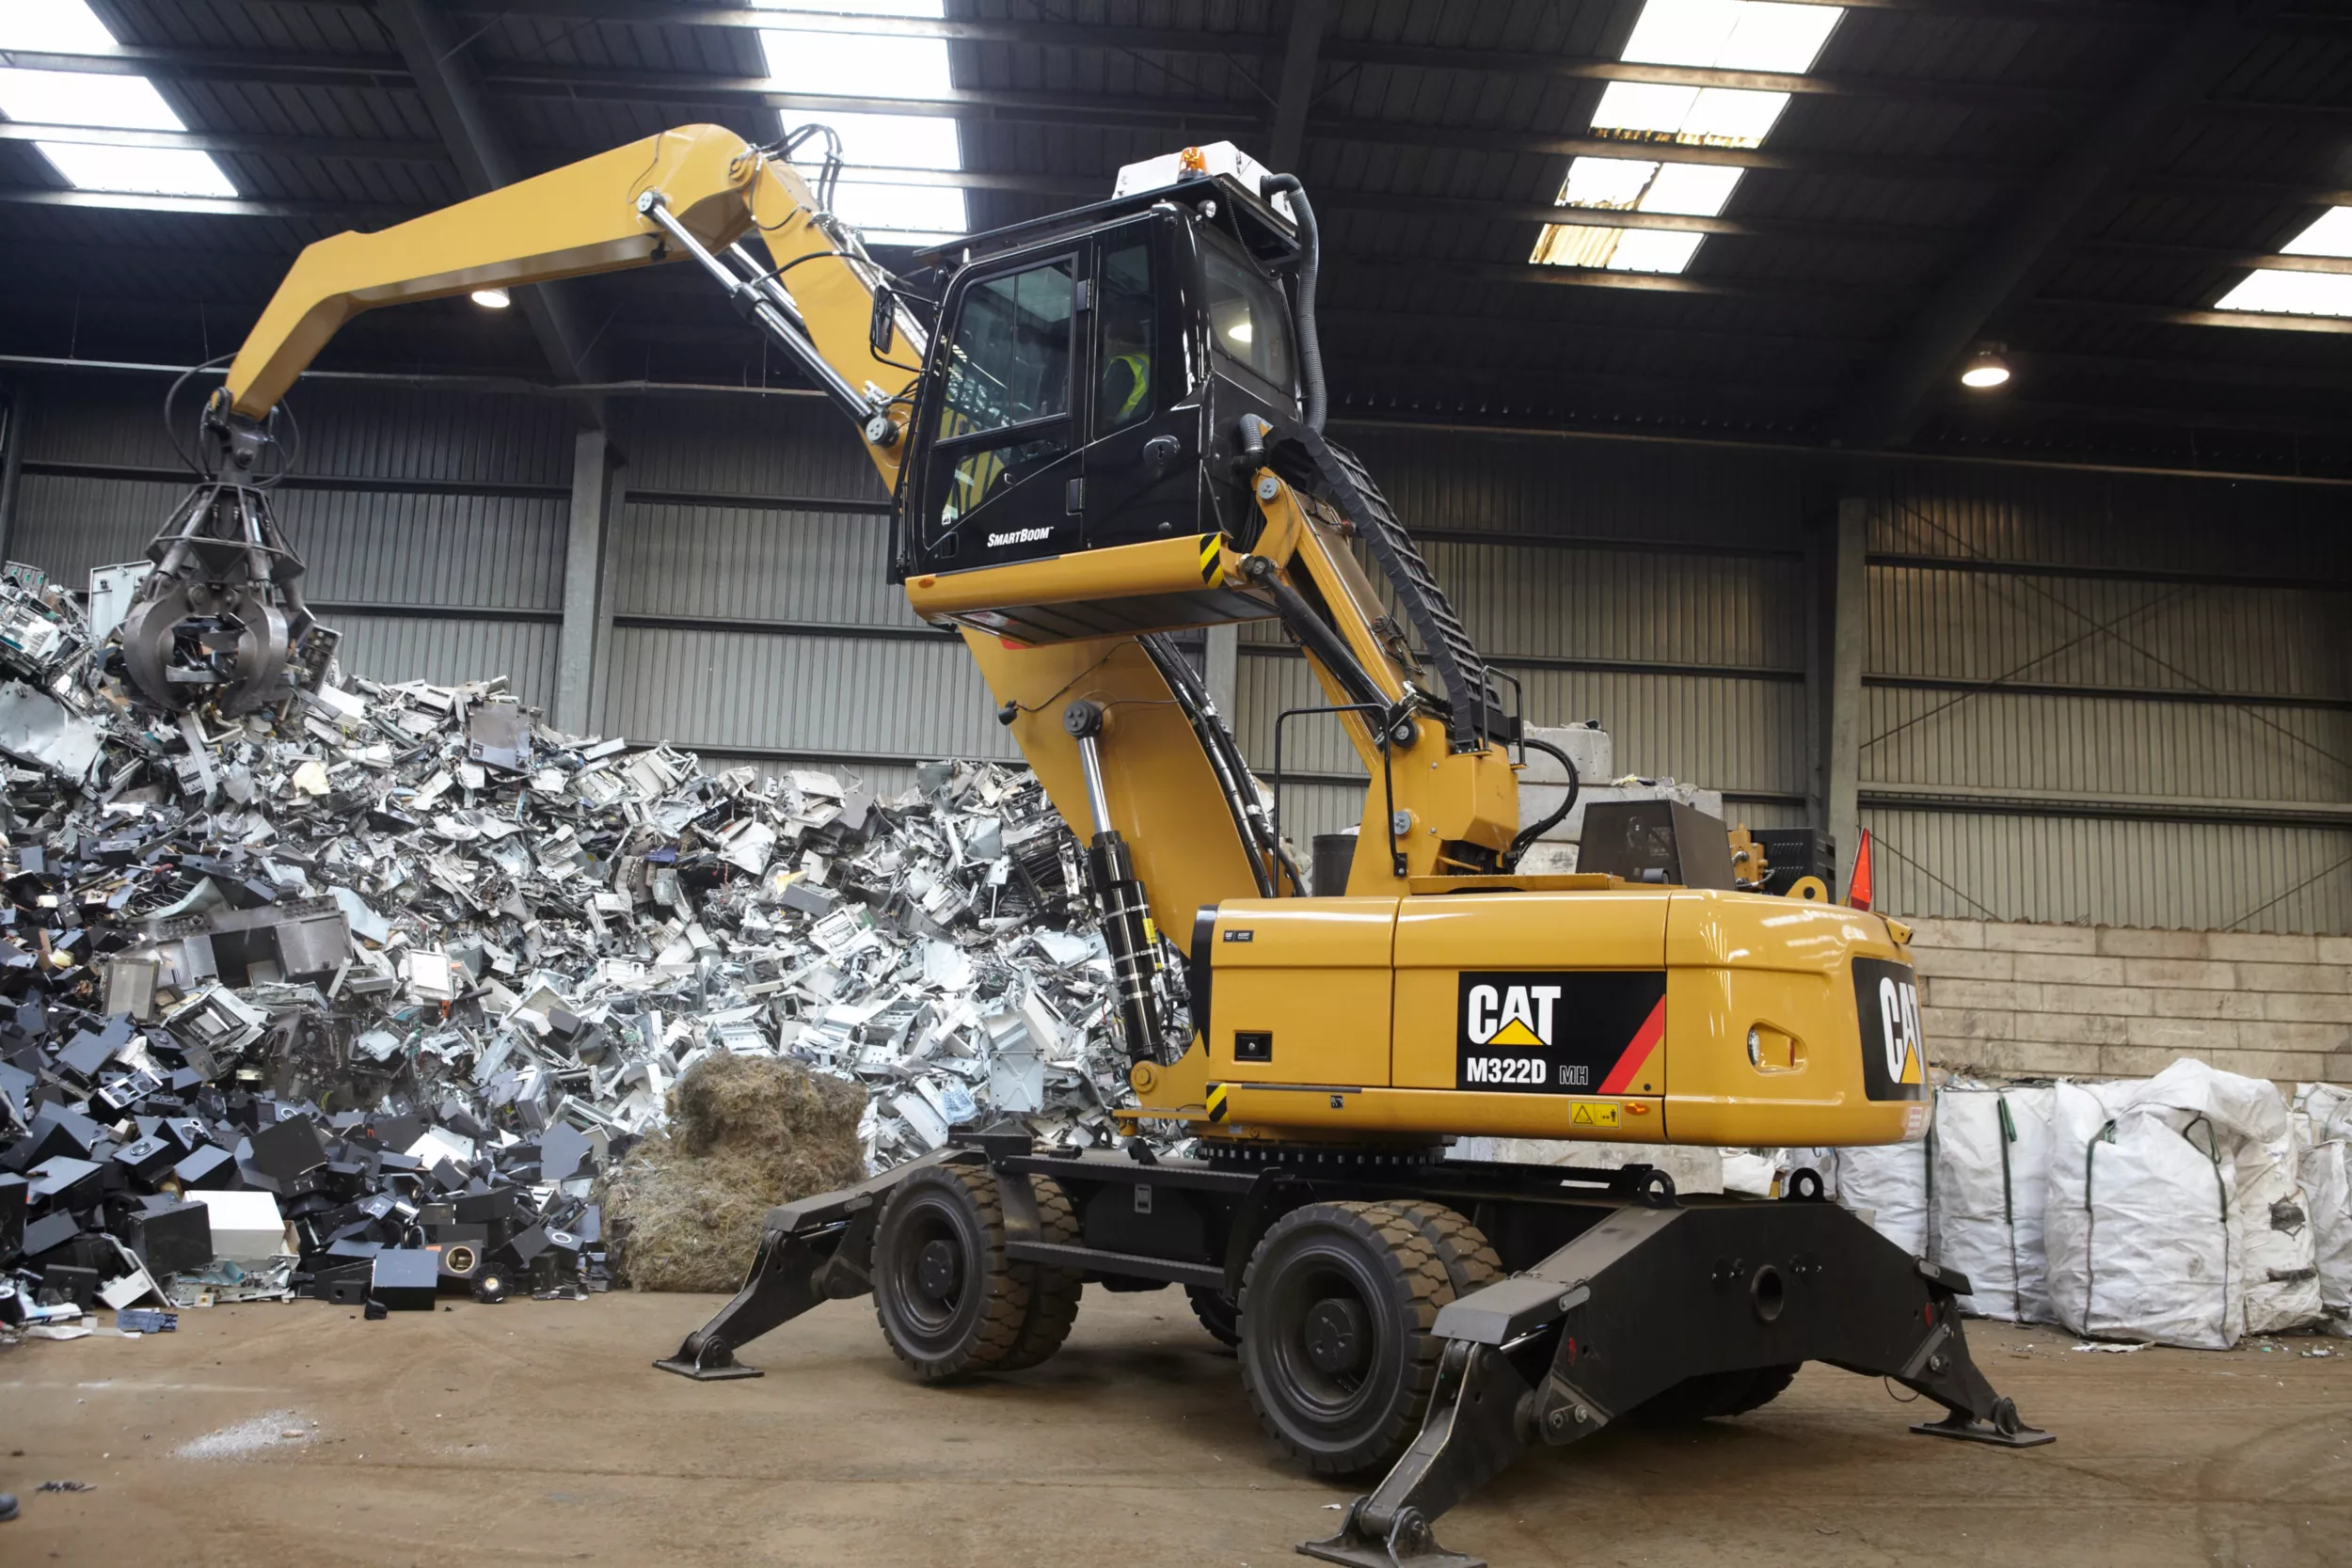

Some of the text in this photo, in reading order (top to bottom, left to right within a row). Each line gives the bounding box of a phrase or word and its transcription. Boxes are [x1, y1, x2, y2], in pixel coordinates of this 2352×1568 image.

[1468, 984, 1562, 1046] CAT
[1467, 1057, 1547, 1084] M322D
[1559, 1065, 1589, 1085] MH
